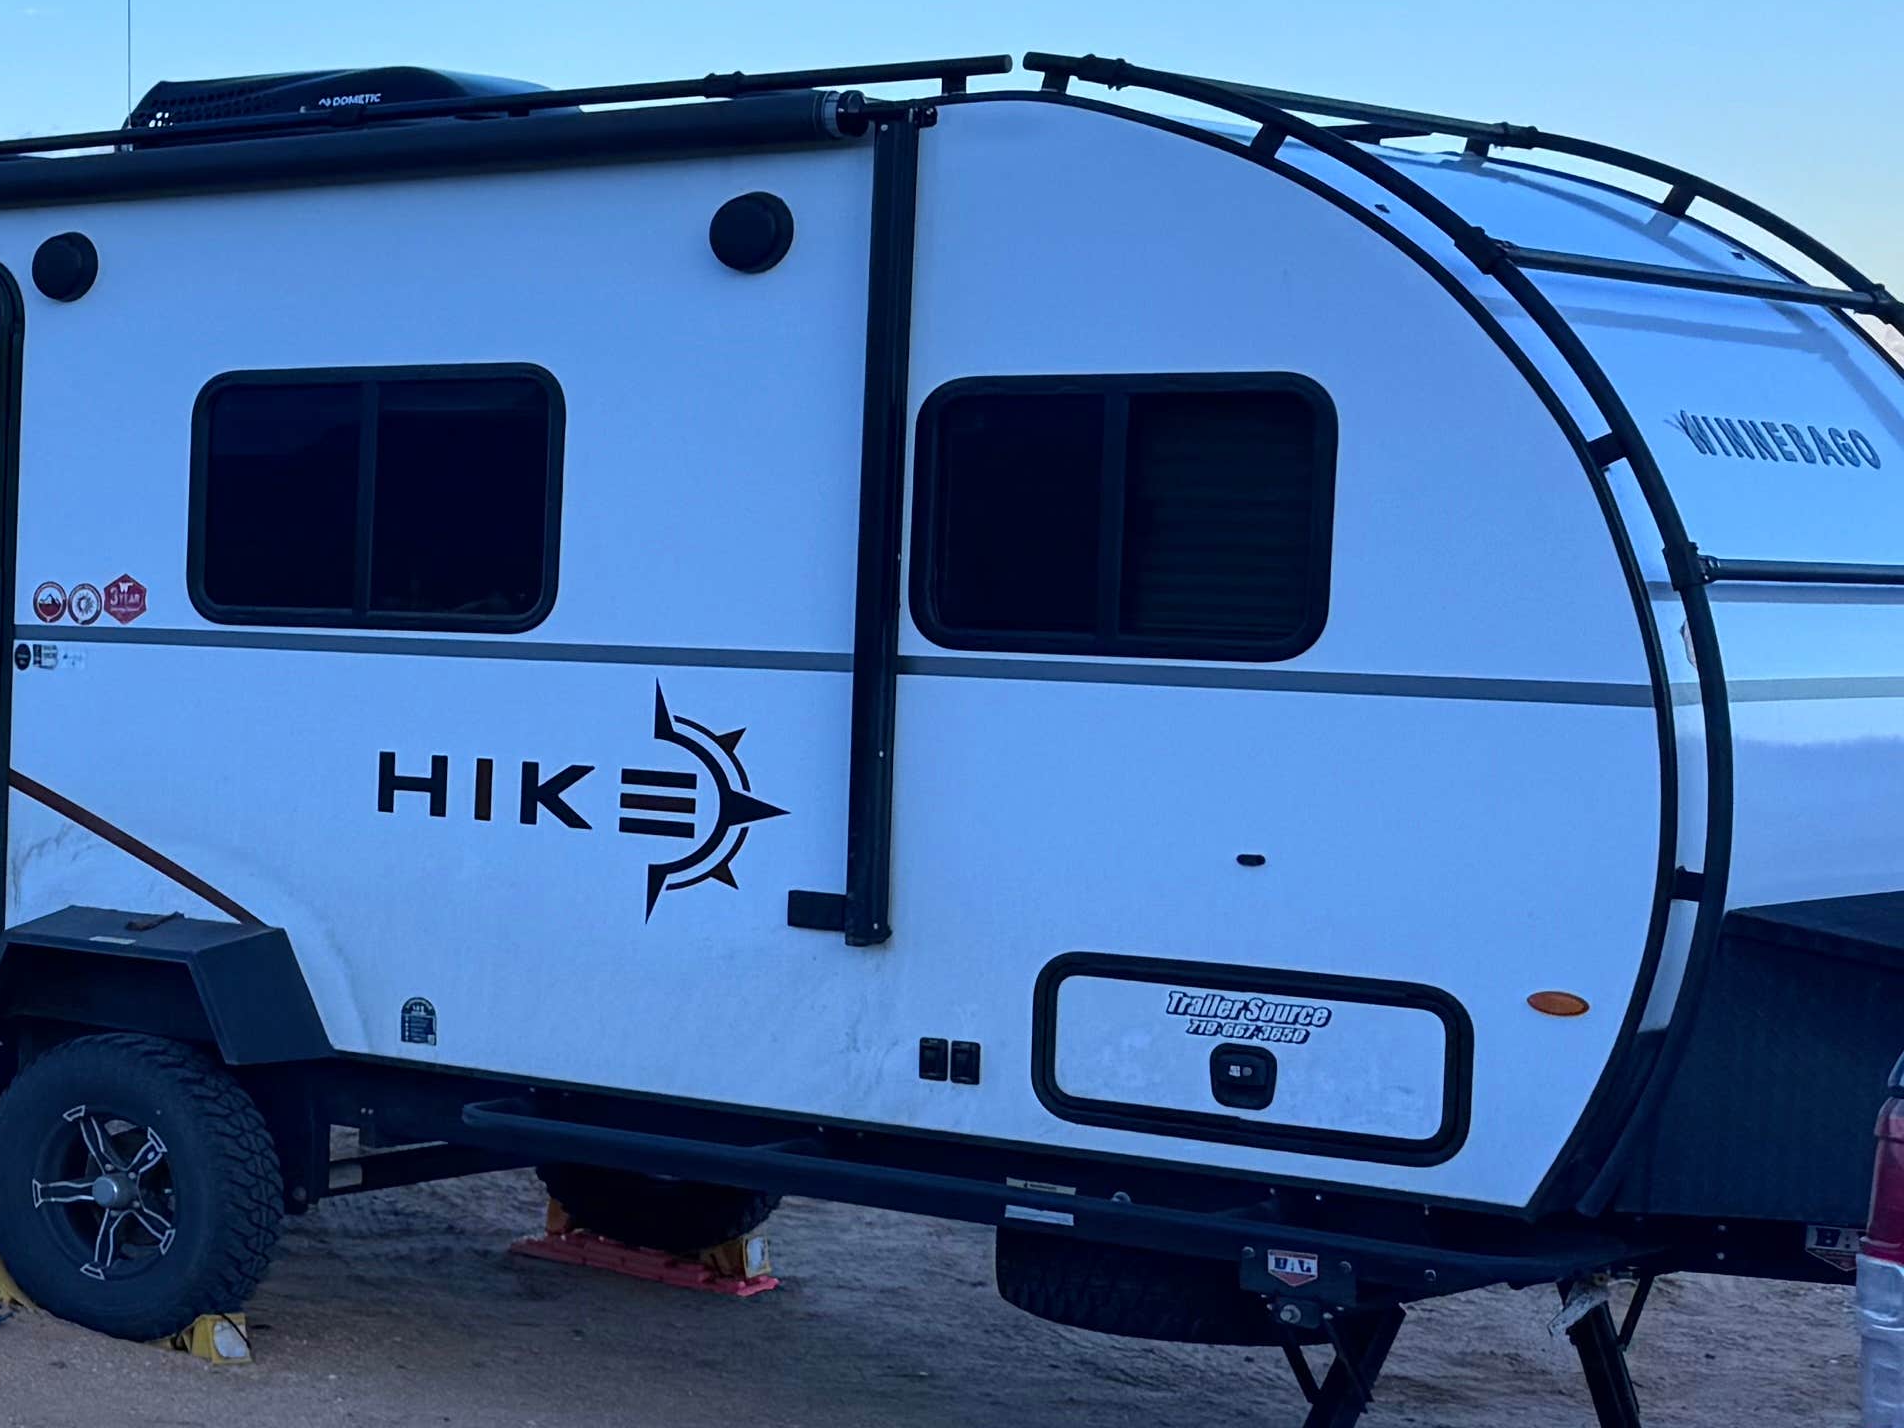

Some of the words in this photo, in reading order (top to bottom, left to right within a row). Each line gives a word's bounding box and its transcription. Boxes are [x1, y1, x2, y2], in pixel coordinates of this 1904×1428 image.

[332, 93, 382, 107] DOMETIC
[1674, 409, 1882, 470] WINNEBAGO
[378, 750, 699, 839] HIKE
[1166, 990, 1245, 1022] Trailer
[1243, 998, 1333, 1028] Source
